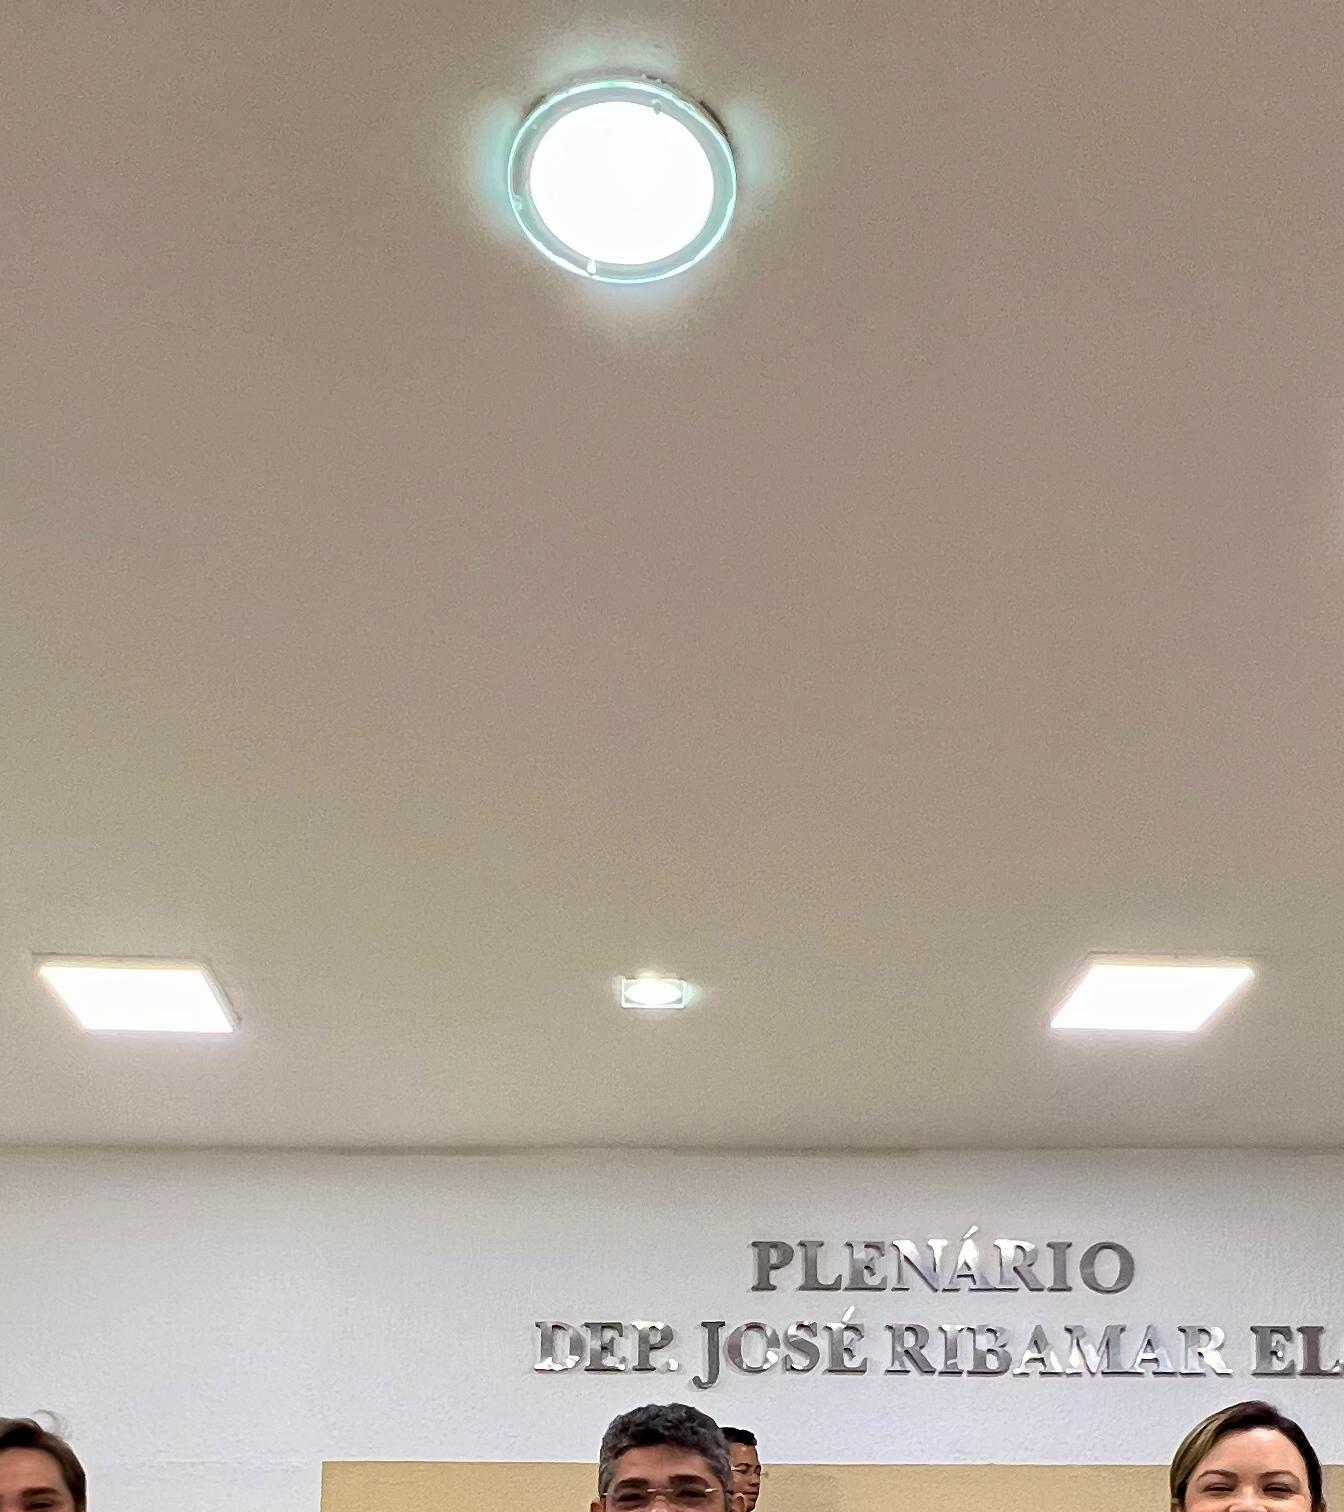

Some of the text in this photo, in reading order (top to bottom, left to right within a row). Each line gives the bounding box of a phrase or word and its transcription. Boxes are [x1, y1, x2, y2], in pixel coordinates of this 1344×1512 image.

[751, 1226, 1135, 1293] PLENÁRIO
[534, 1320, 678, 1373] DEP.
[692, 1306, 868, 1389] JOSÉ
[885, 1322, 1233, 1377] RIBAMAR
